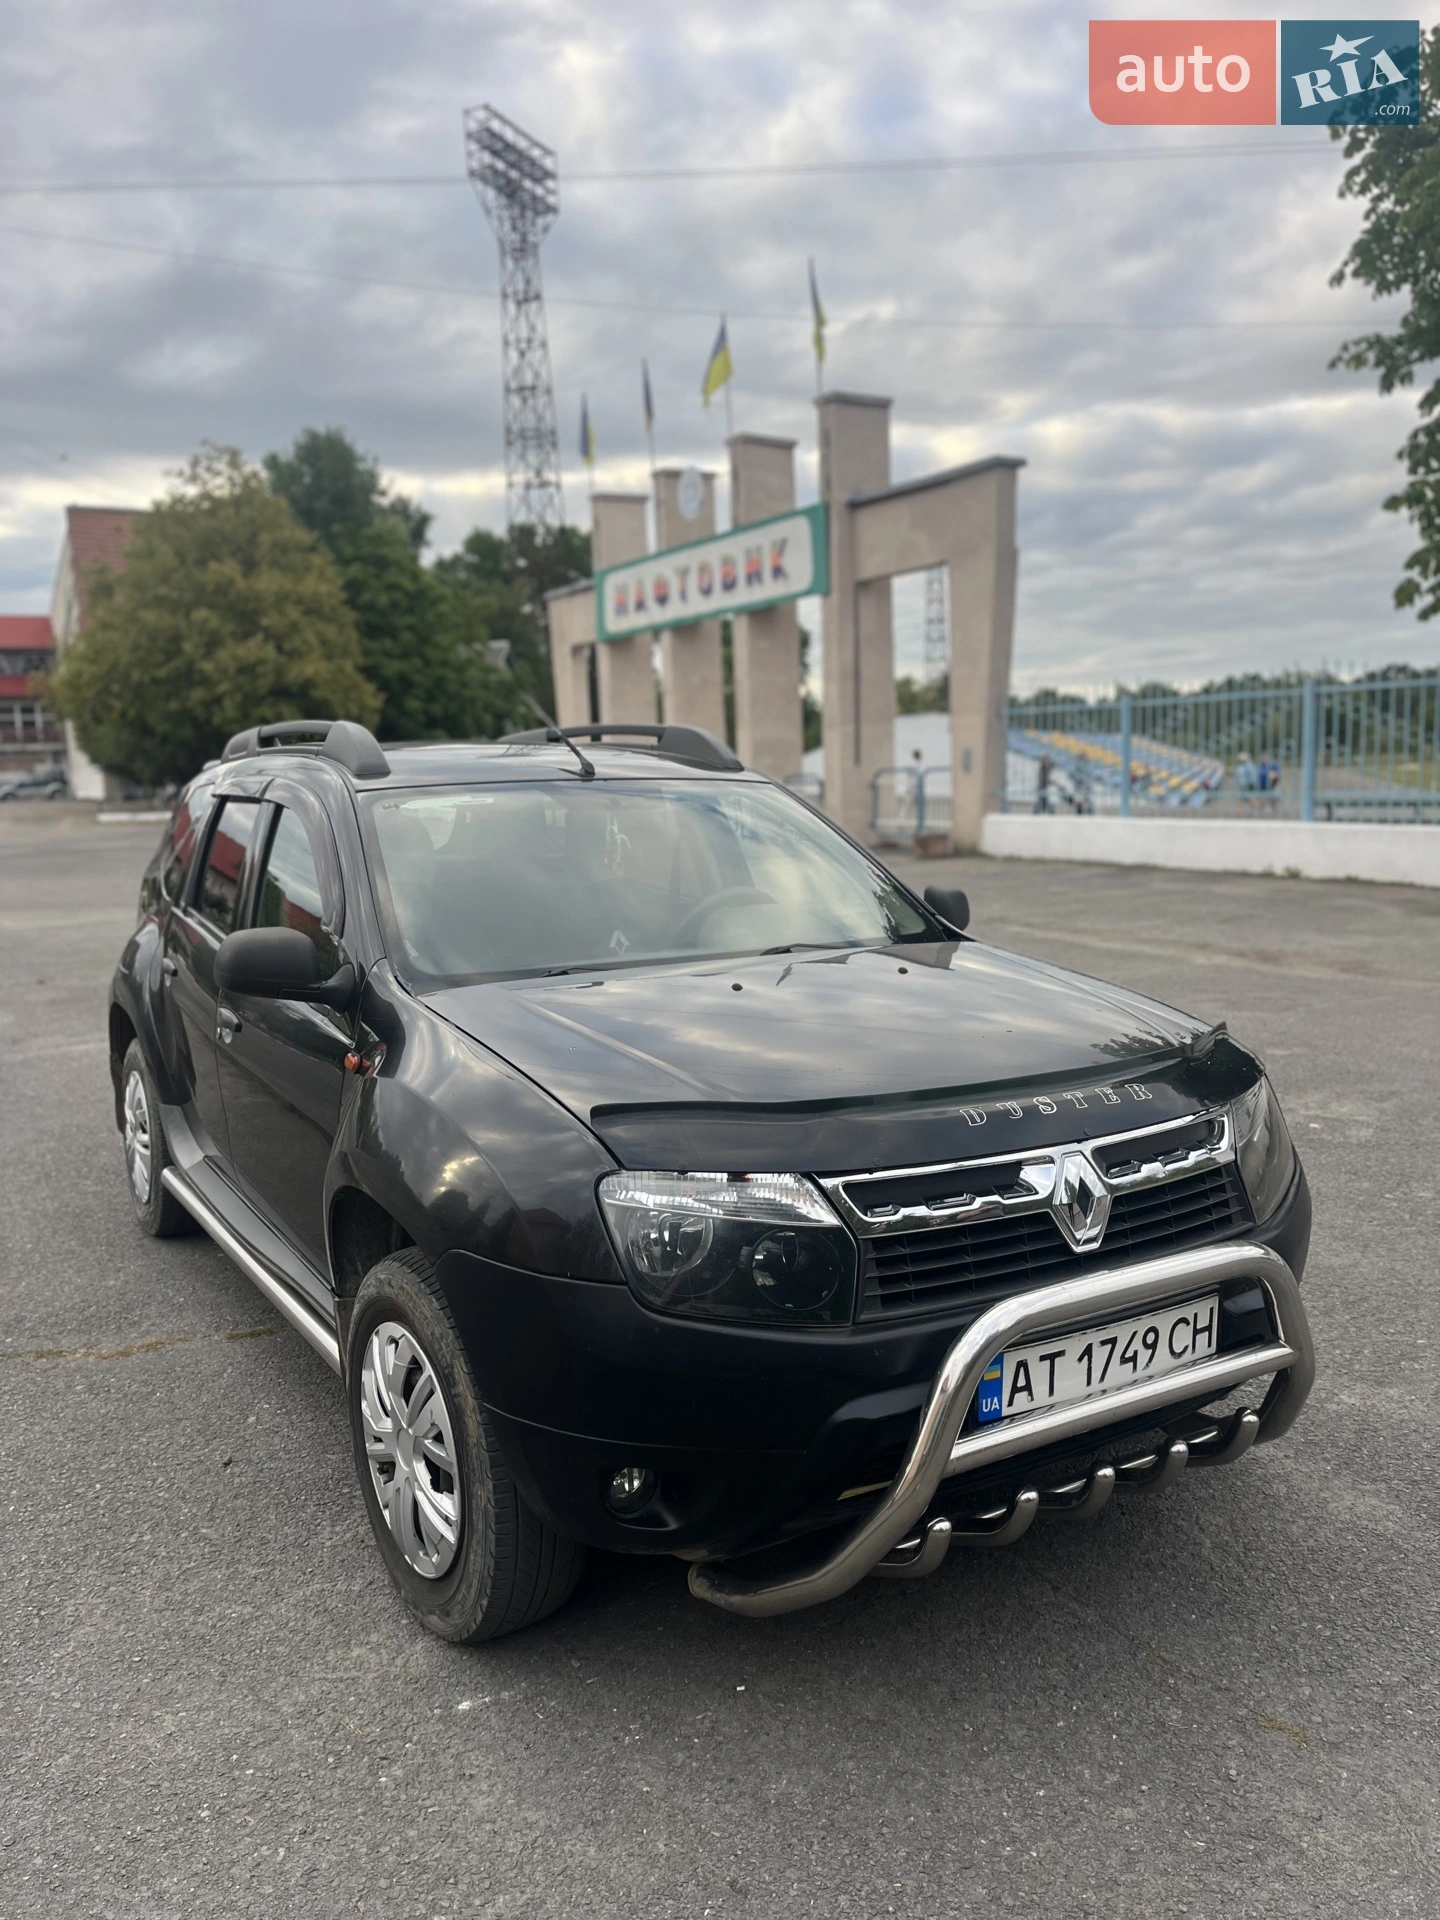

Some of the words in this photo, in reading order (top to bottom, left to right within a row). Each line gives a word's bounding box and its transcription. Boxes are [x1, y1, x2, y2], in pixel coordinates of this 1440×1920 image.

[959, 1083, 1152, 1126] DUSTER
[1006, 1349, 1066, 1407] AT
[1077, 1325, 1160, 1387] 1749
[1168, 1306, 1214, 1360] CH
[982, 1396, 1000, 1412] UA
